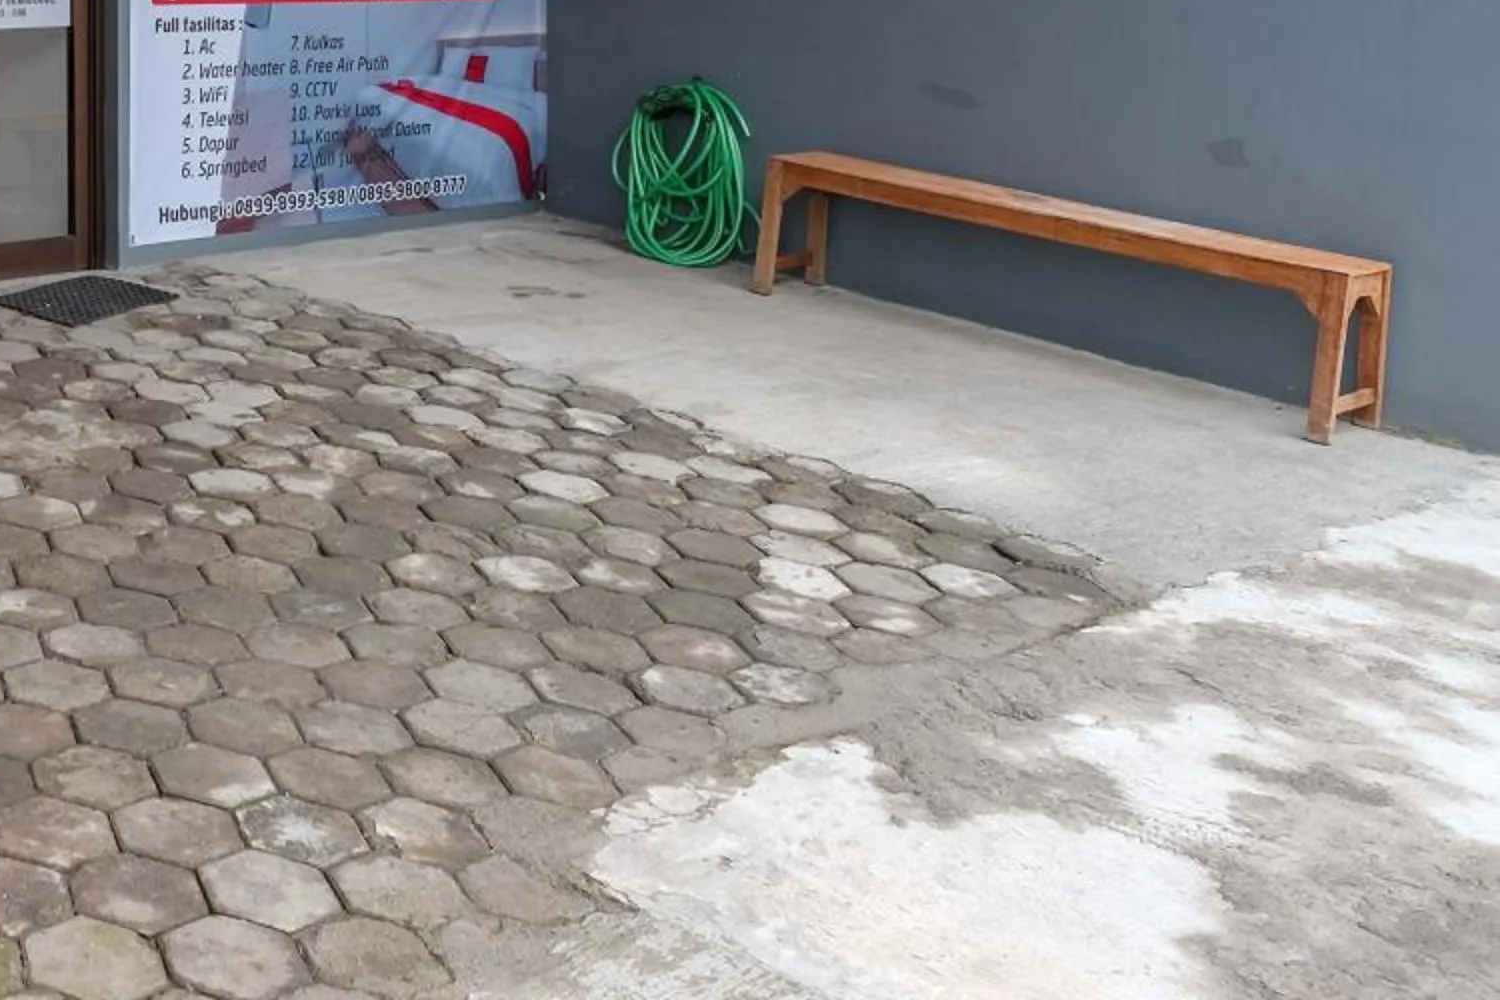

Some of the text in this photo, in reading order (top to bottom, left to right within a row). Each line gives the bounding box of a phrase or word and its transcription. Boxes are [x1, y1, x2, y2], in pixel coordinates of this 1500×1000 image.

[155, 17, 179, 34] Full
[183, 17, 235, 33] fasilitas
[183, 38, 217, 55] 1. Ac
[291, 34, 345, 51] 7. Kulkas
[182, 60, 286, 80] 2. Water heater
[289, 55, 389, 75] 8. Free Air Putih
[182, 85, 229, 105] 3. WiFi
[289, 81, 338, 99] 9. CCTV
[181, 108, 250, 129] 4. Televisi
[291, 105, 311, 122] 10.
[355, 102, 382, 118] Luas
[395, 120, 432, 138] Dalam
[181, 135, 240, 156] 5. Dapur
[181, 156, 267, 181] 6. Springbed
